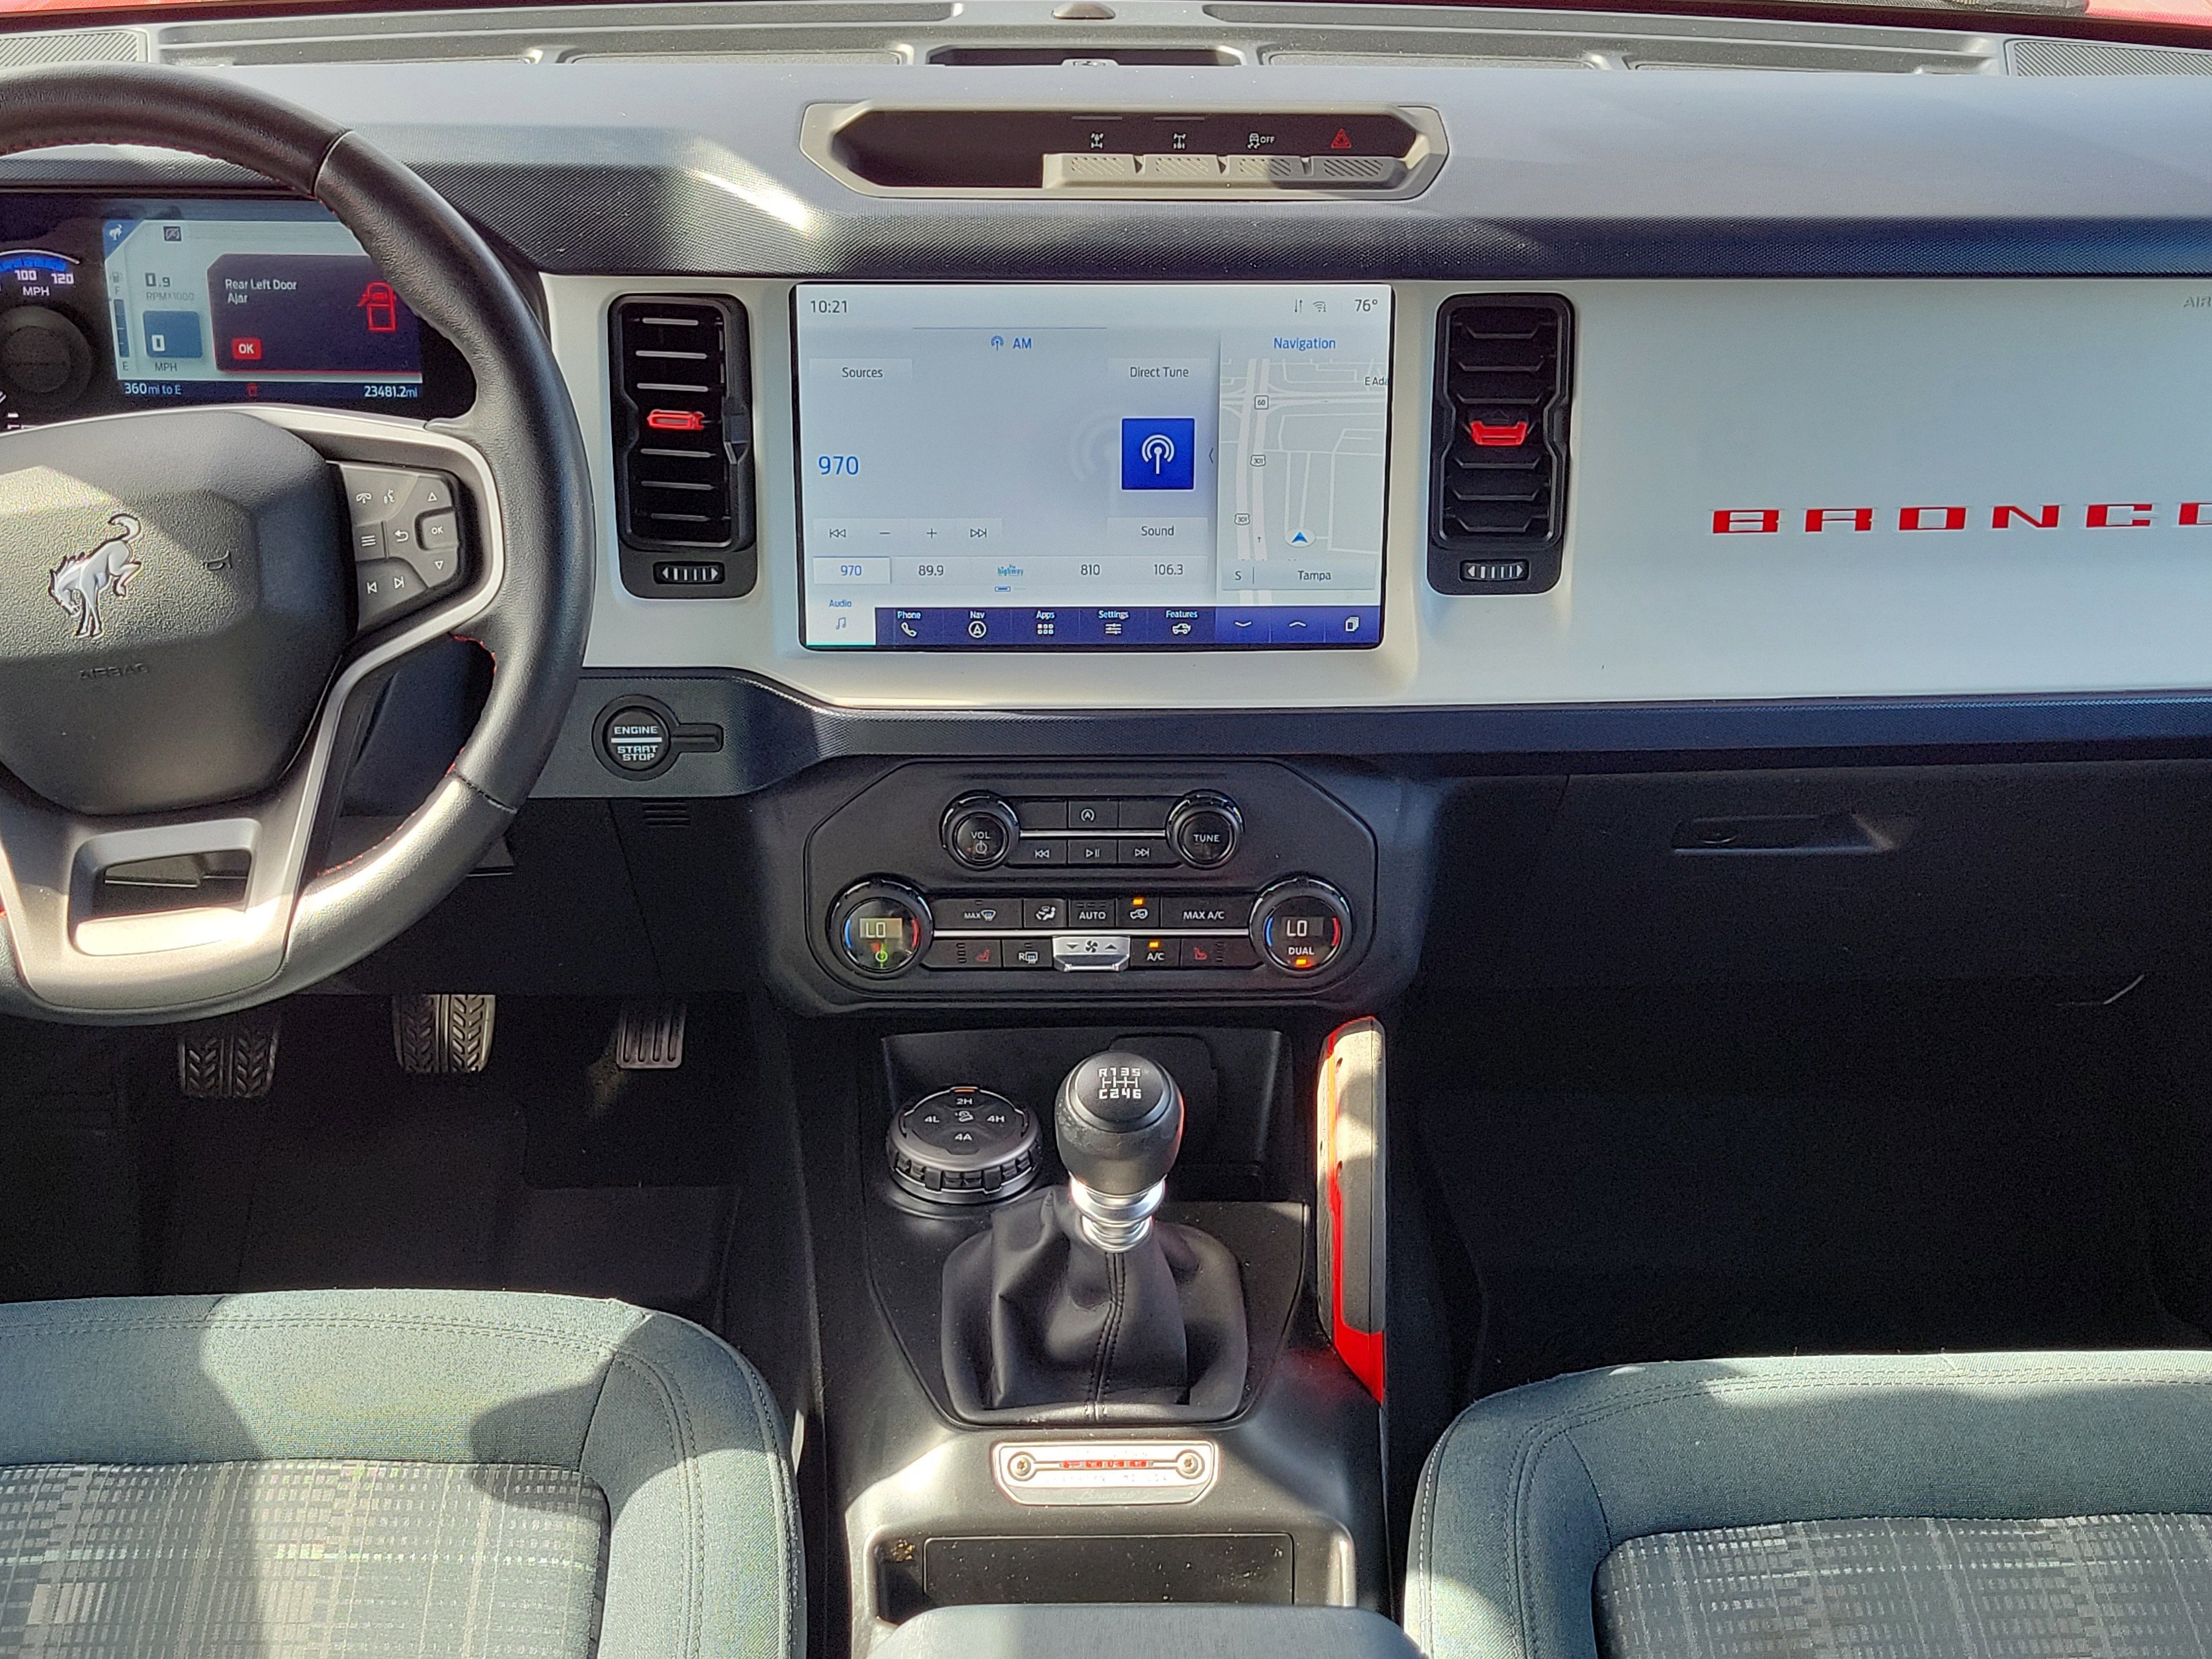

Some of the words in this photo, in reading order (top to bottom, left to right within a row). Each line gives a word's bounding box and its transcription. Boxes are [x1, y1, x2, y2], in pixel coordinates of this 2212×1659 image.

[14, 269, 37, 281] 100
[51, 273, 74, 284] 120
[225, 279, 247, 290] Rear
[250, 279, 269, 290] Left
[273, 279, 297, 290] Door
[22, 286, 50, 296] MPH
[115, 286, 120, 295] F
[227, 292, 248, 304] Ajar
[810, 300, 848, 313] 10:21
[1355, 299, 1378, 312] 76°
[239, 343, 254, 354] OK
[1013, 338, 1032, 349] AM
[1273, 337, 1336, 350] Navigation
[122, 362, 128, 370] E
[155, 362, 177, 371] MPH
[842, 366, 883, 378] Sources
[1130, 366, 1160, 377] Direct
[1163, 366, 1189, 377] Tune
[1365, 376, 1370, 386] E
[818, 456, 859, 476] 970
[1141, 526, 1175, 536] Sound
[840, 565, 862, 576] 970
[918, 565, 944, 576] 89.9
[1080, 565, 1100, 575] 810
[1154, 565, 1183, 575] 106.3
[1234, 571, 1242, 580] S
[1297, 571, 1331, 582] Tampa
[829, 599, 852, 607] Audio
[897, 611, 921, 619] Phone
[970, 611, 985, 619] Nav
[1036, 611, 1055, 620] Apps
[1098, 610, 1129, 619] Settings
[1166, 610, 1198, 618] Features
[614, 726, 658, 735] ENGINE
[618, 745, 658, 753] START
[623, 753, 654, 761] STOP
[971, 831, 990, 840] VOL
[1208, 911, 1224, 920] A/C
[1147, 952, 1165, 961] A/C
[1288, 947, 1314, 956] DUAL
[955, 1133, 972, 1142] 4A
